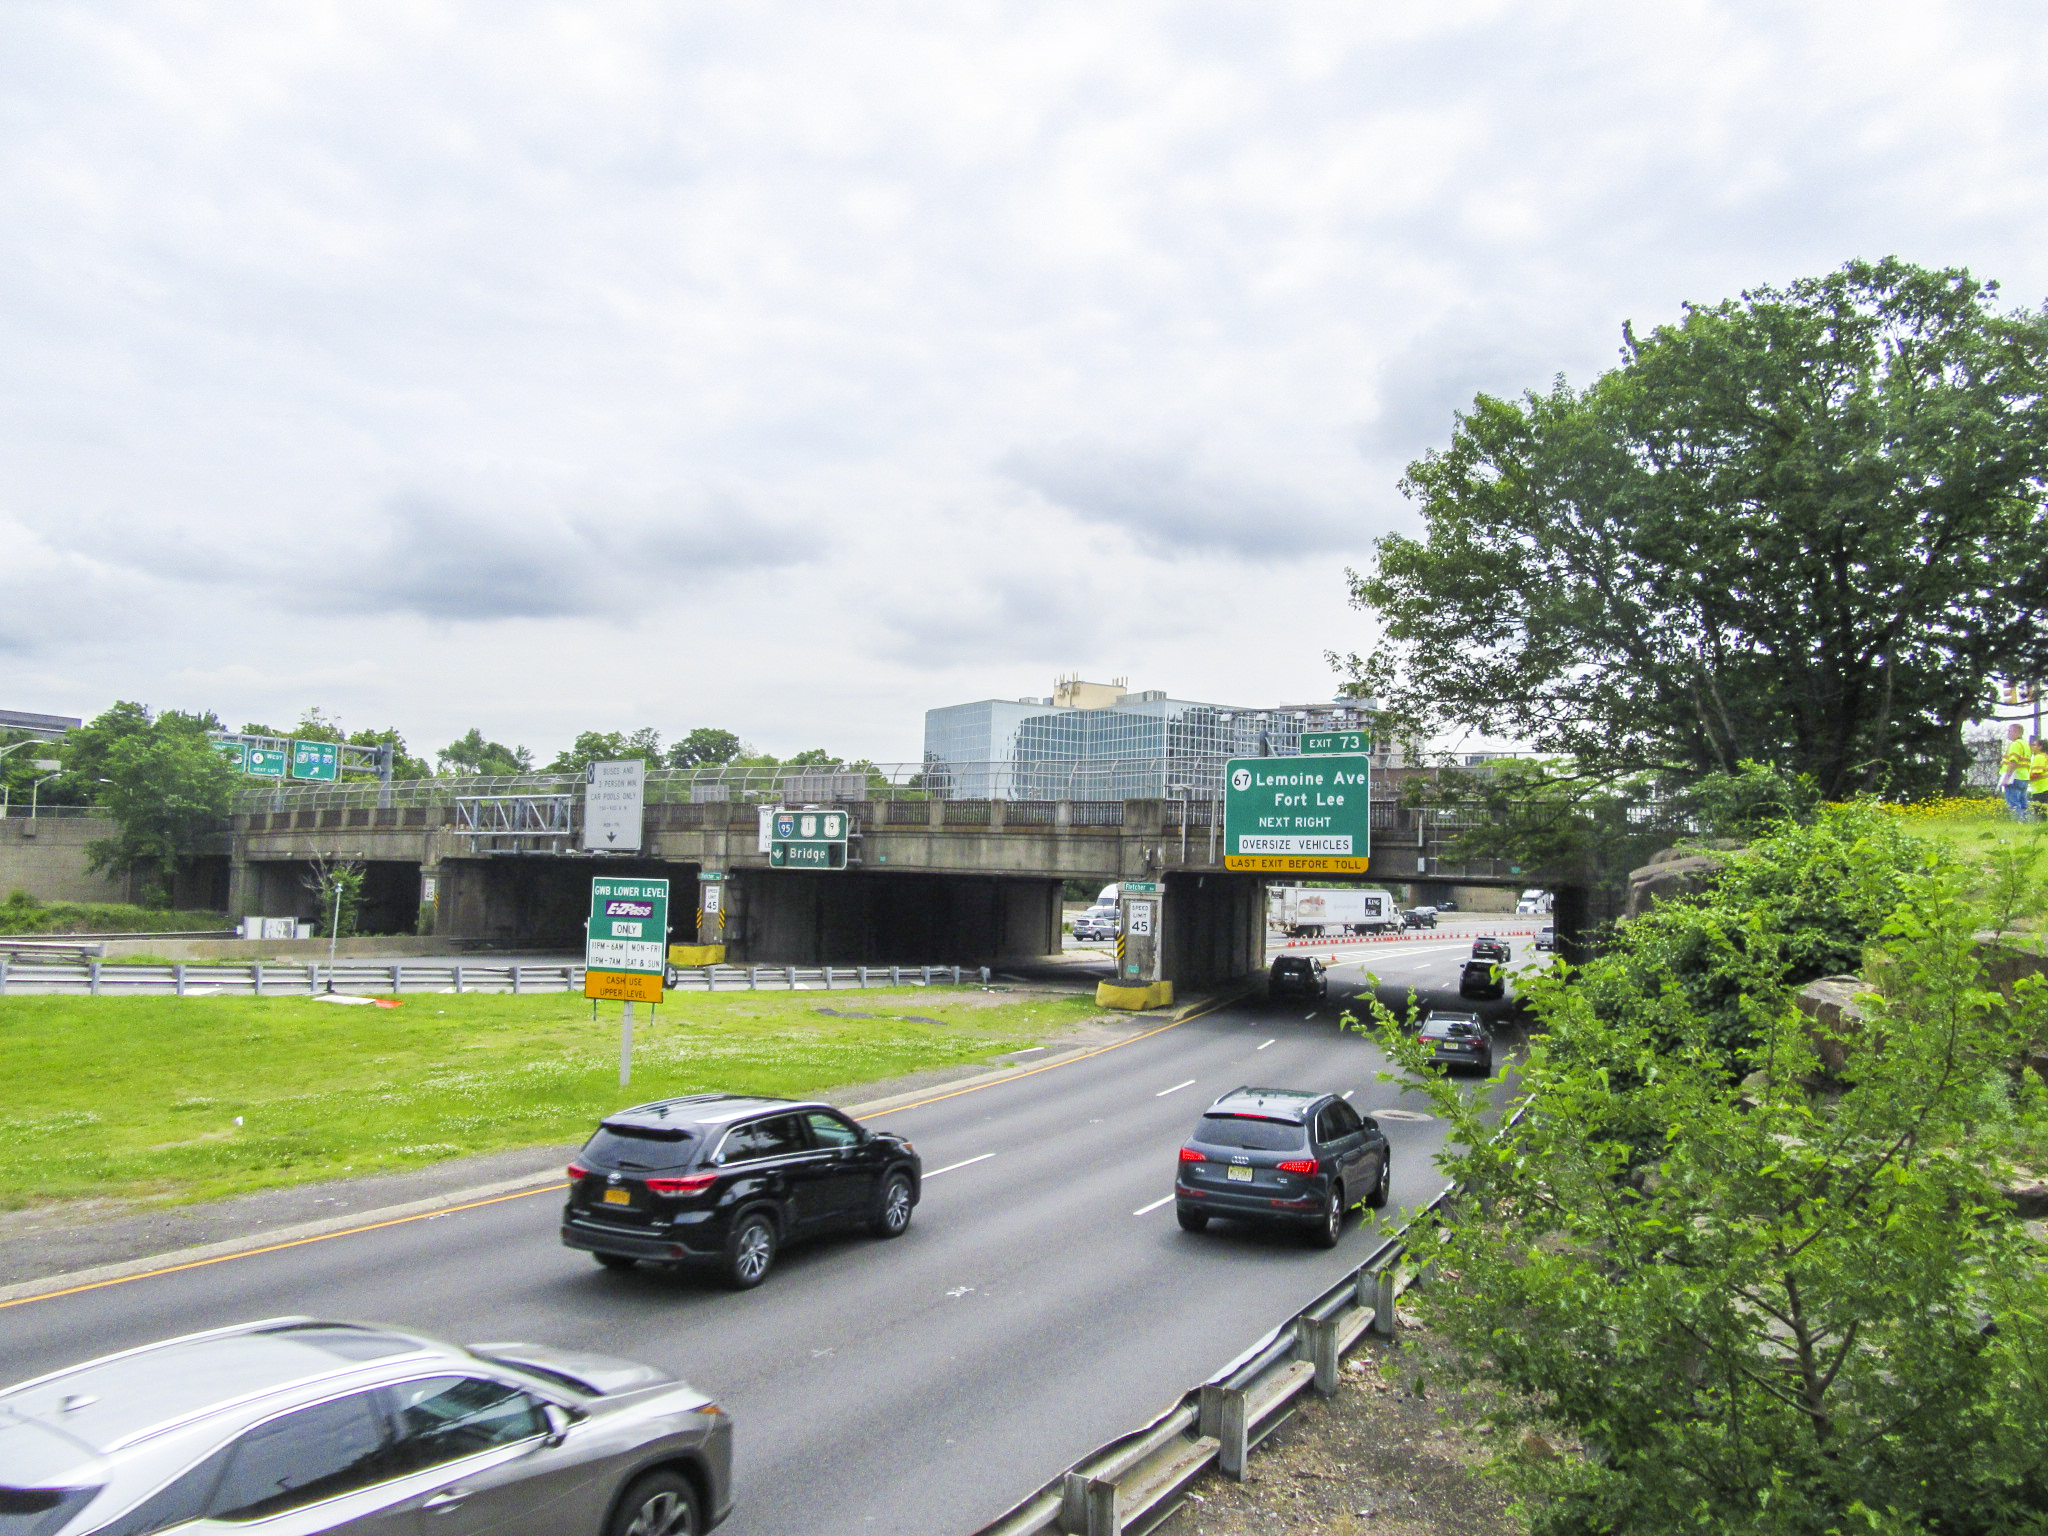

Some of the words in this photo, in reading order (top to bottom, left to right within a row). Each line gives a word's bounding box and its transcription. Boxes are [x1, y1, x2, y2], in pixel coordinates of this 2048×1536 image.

[1309, 738, 1332, 748] EXIT
[1339, 735, 1360, 749] 73
[623, 766, 634, 775] AND
[1233, 774, 1250, 786] 67
[1256, 772, 1324, 786] Lemoine
[1333, 771, 1365, 785] Ave
[623, 792, 636, 800] ONLY
[1275, 792, 1307, 806] Fort
[1316, 792, 1345, 806] Lee
[829, 822, 834, 830] 9
[1259, 817, 1290, 827] NEXT
[1295, 817, 1332, 828] RIGHT
[781, 824, 791, 833] 95
[1242, 839, 1291, 850] OVERSIZE
[1298, 839, 1349, 850] VEHICLES
[789, 847, 826, 863] Bridge
[1231, 859, 1256, 868] LAST
[1261, 859, 1283, 868] EXIT
[1288, 860, 1329, 869] BEFORE
[1335, 860, 1361, 870] TOLL
[594, 885, 611, 896] GWB
[613, 886, 640, 897] LOWER
[642, 887, 667, 898] LEVEL
[606, 902, 652, 916] E-ZPass
[706, 901, 717, 910] 45
[616, 924, 637, 934] ONLY
[1131, 921, 1148, 932] 45
[626, 958, 637, 967] SAT
[639, 959, 645, 967] &
[648, 959, 660, 968] SUN
[606, 976, 626, 985] CASH
[628, 978, 643, 986] USE
[600, 988, 623, 997] UPPER
[626, 989, 647, 999] LEVEL
